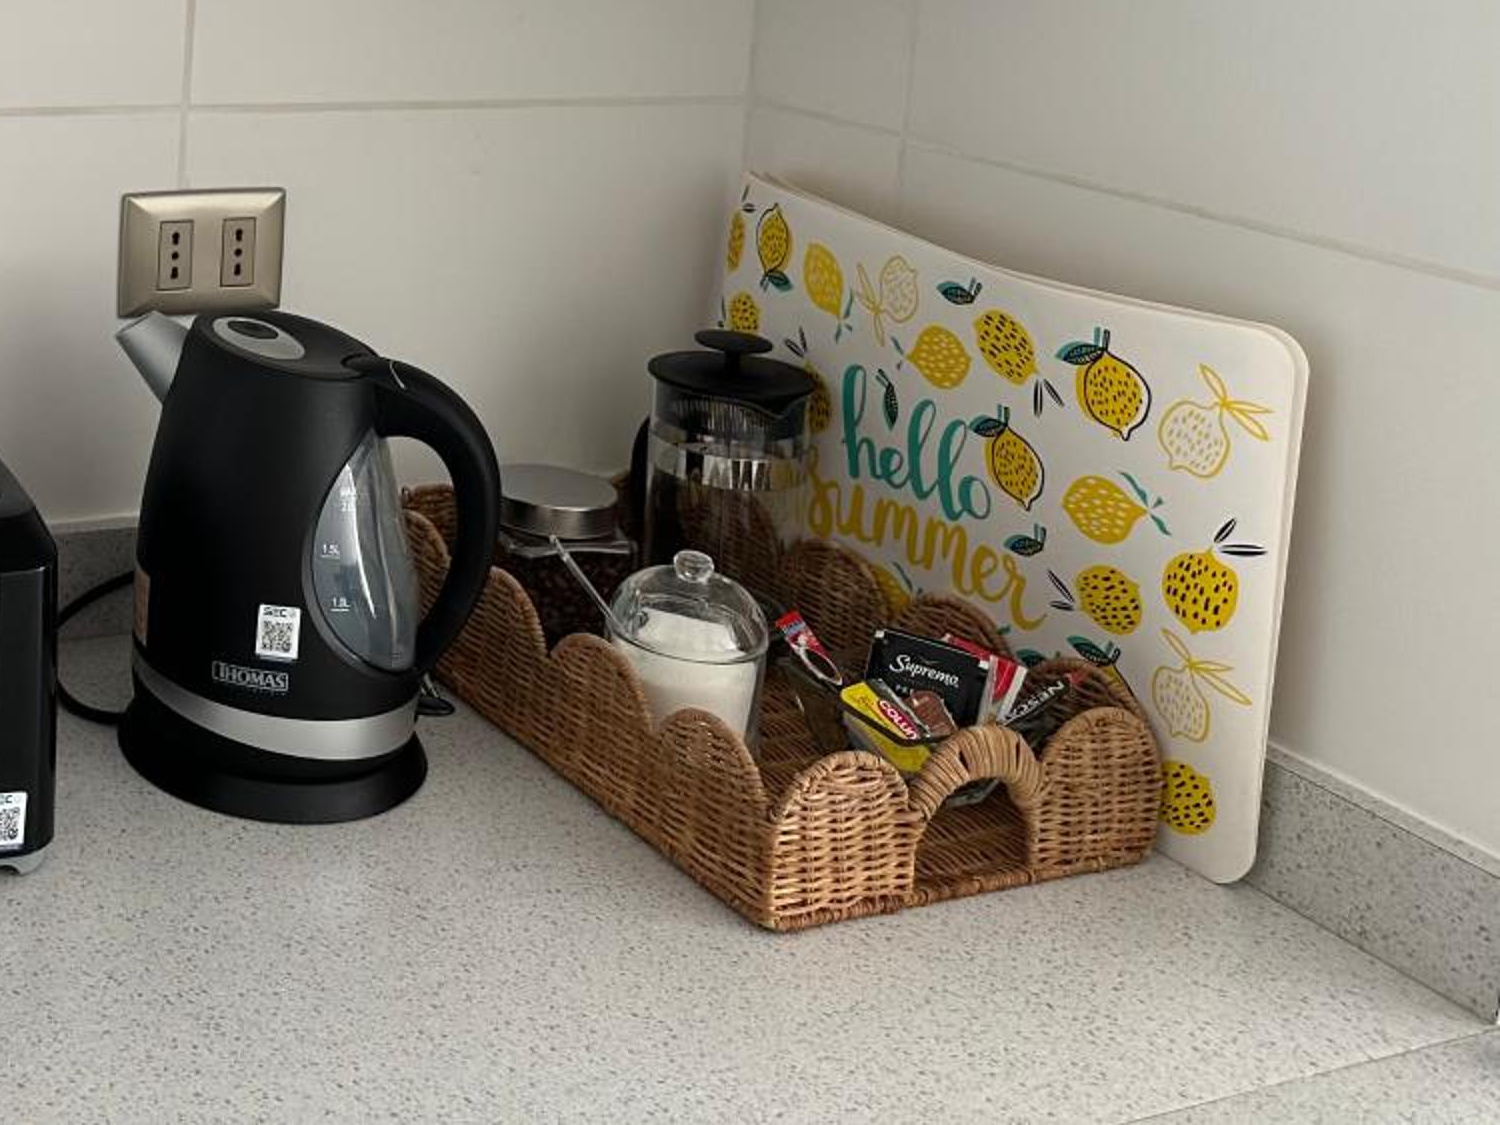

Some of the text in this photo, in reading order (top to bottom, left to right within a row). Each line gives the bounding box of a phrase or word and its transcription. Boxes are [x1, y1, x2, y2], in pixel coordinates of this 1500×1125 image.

[842, 364, 991, 521] hello
[807, 445, 1047, 631] summer
[218, 663, 285, 688] THOMAS
